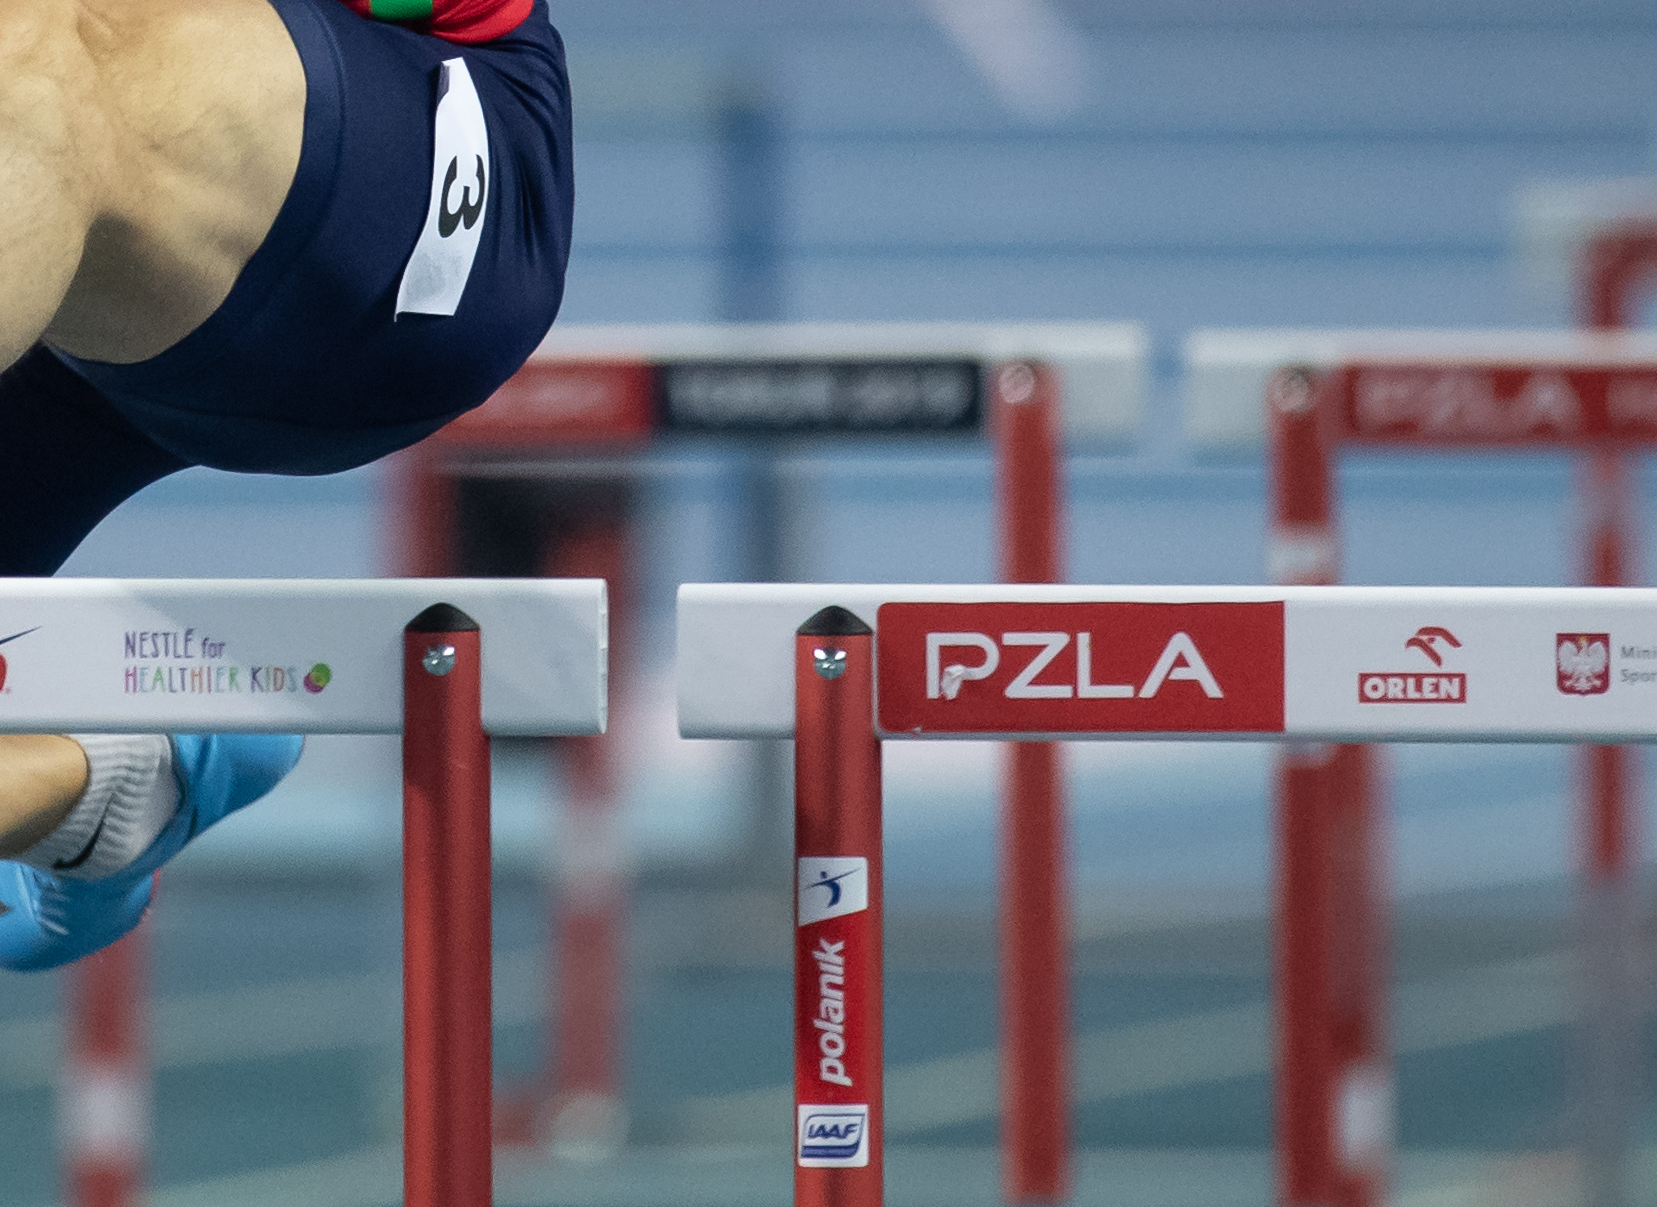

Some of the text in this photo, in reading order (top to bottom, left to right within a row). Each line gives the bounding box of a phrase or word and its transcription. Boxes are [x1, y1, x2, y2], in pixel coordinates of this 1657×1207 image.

[438, 154, 486, 238] 3
[201, 636, 226, 659] for
[124, 665, 298, 694] HEALTHIER KIDS
[926, 631, 1224, 700] PZLA
[1364, 677, 1461, 700] ORLEN
[812, 938, 853, 1087] polanik
[807, 1123, 860, 1140] IAAF
